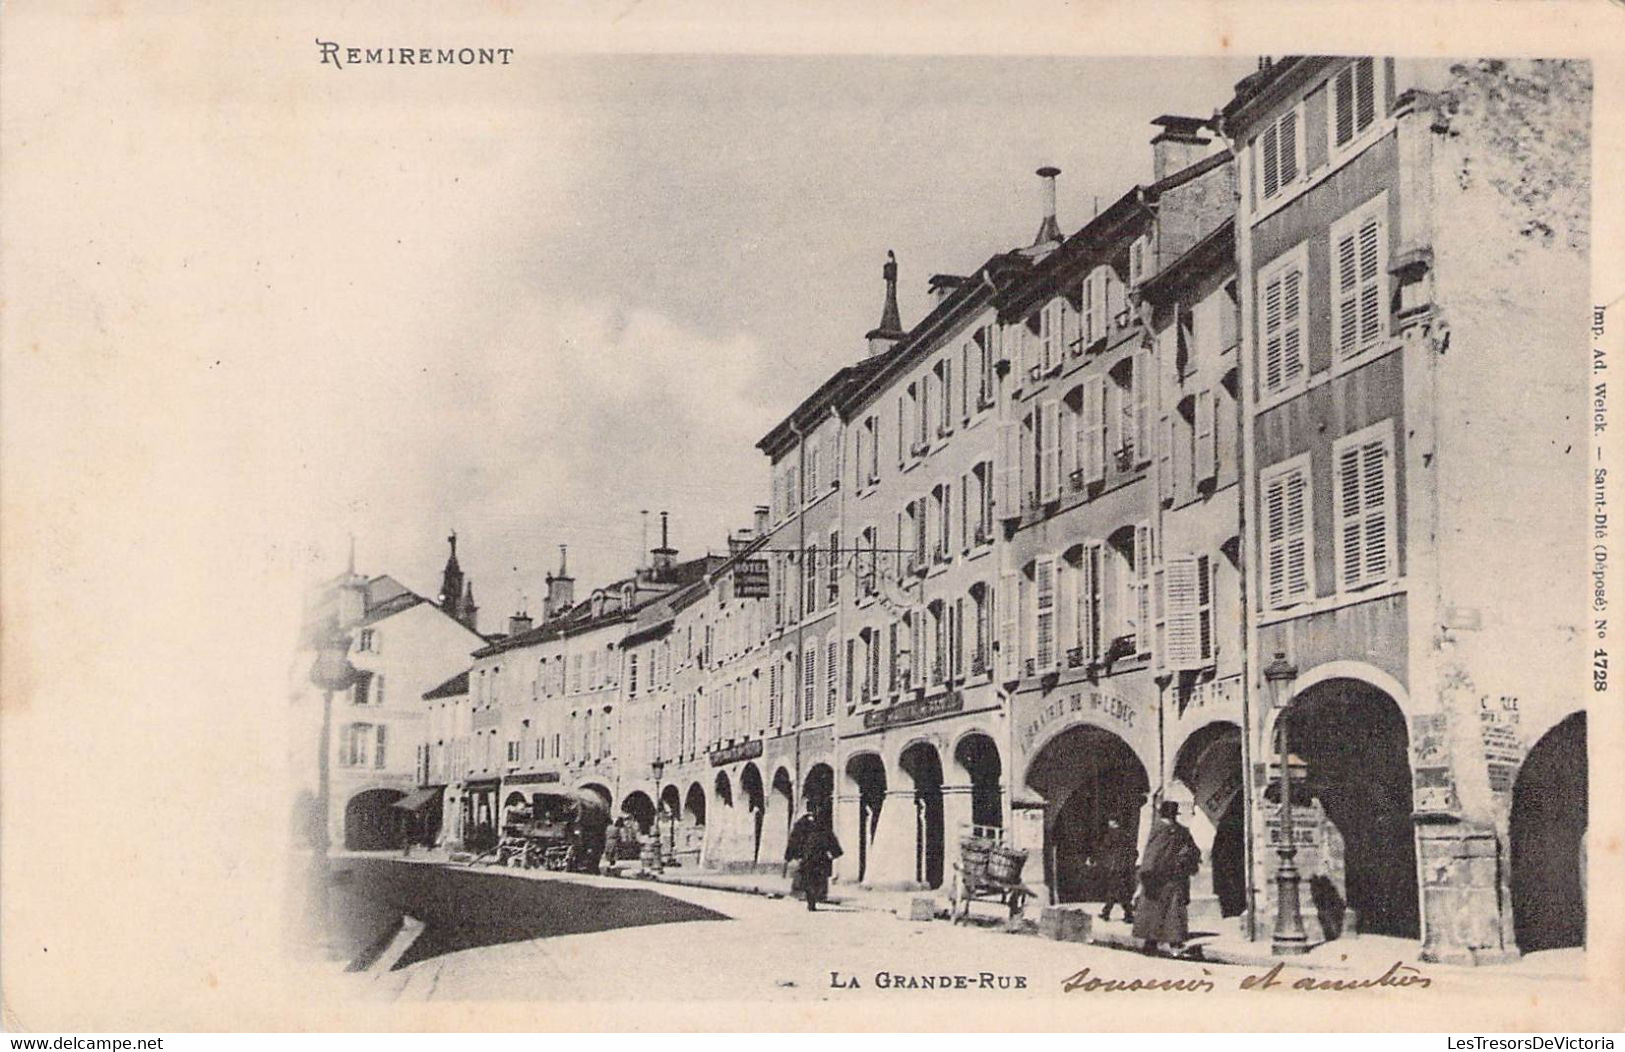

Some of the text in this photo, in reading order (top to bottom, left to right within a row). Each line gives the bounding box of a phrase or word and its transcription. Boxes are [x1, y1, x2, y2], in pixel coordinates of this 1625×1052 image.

[315, 38, 514, 70] REMIREMONT
[1591, 305, 1607, 341] Imp.
[1593, 348, 1608, 375] Ad.
[1594, 382, 1608, 437] Weick.
[1593, 648, 1608, 692] 1728
[830, 971, 1027, 989] LA GRANDE-RUE
[1239, 961, 1287, 992] et
